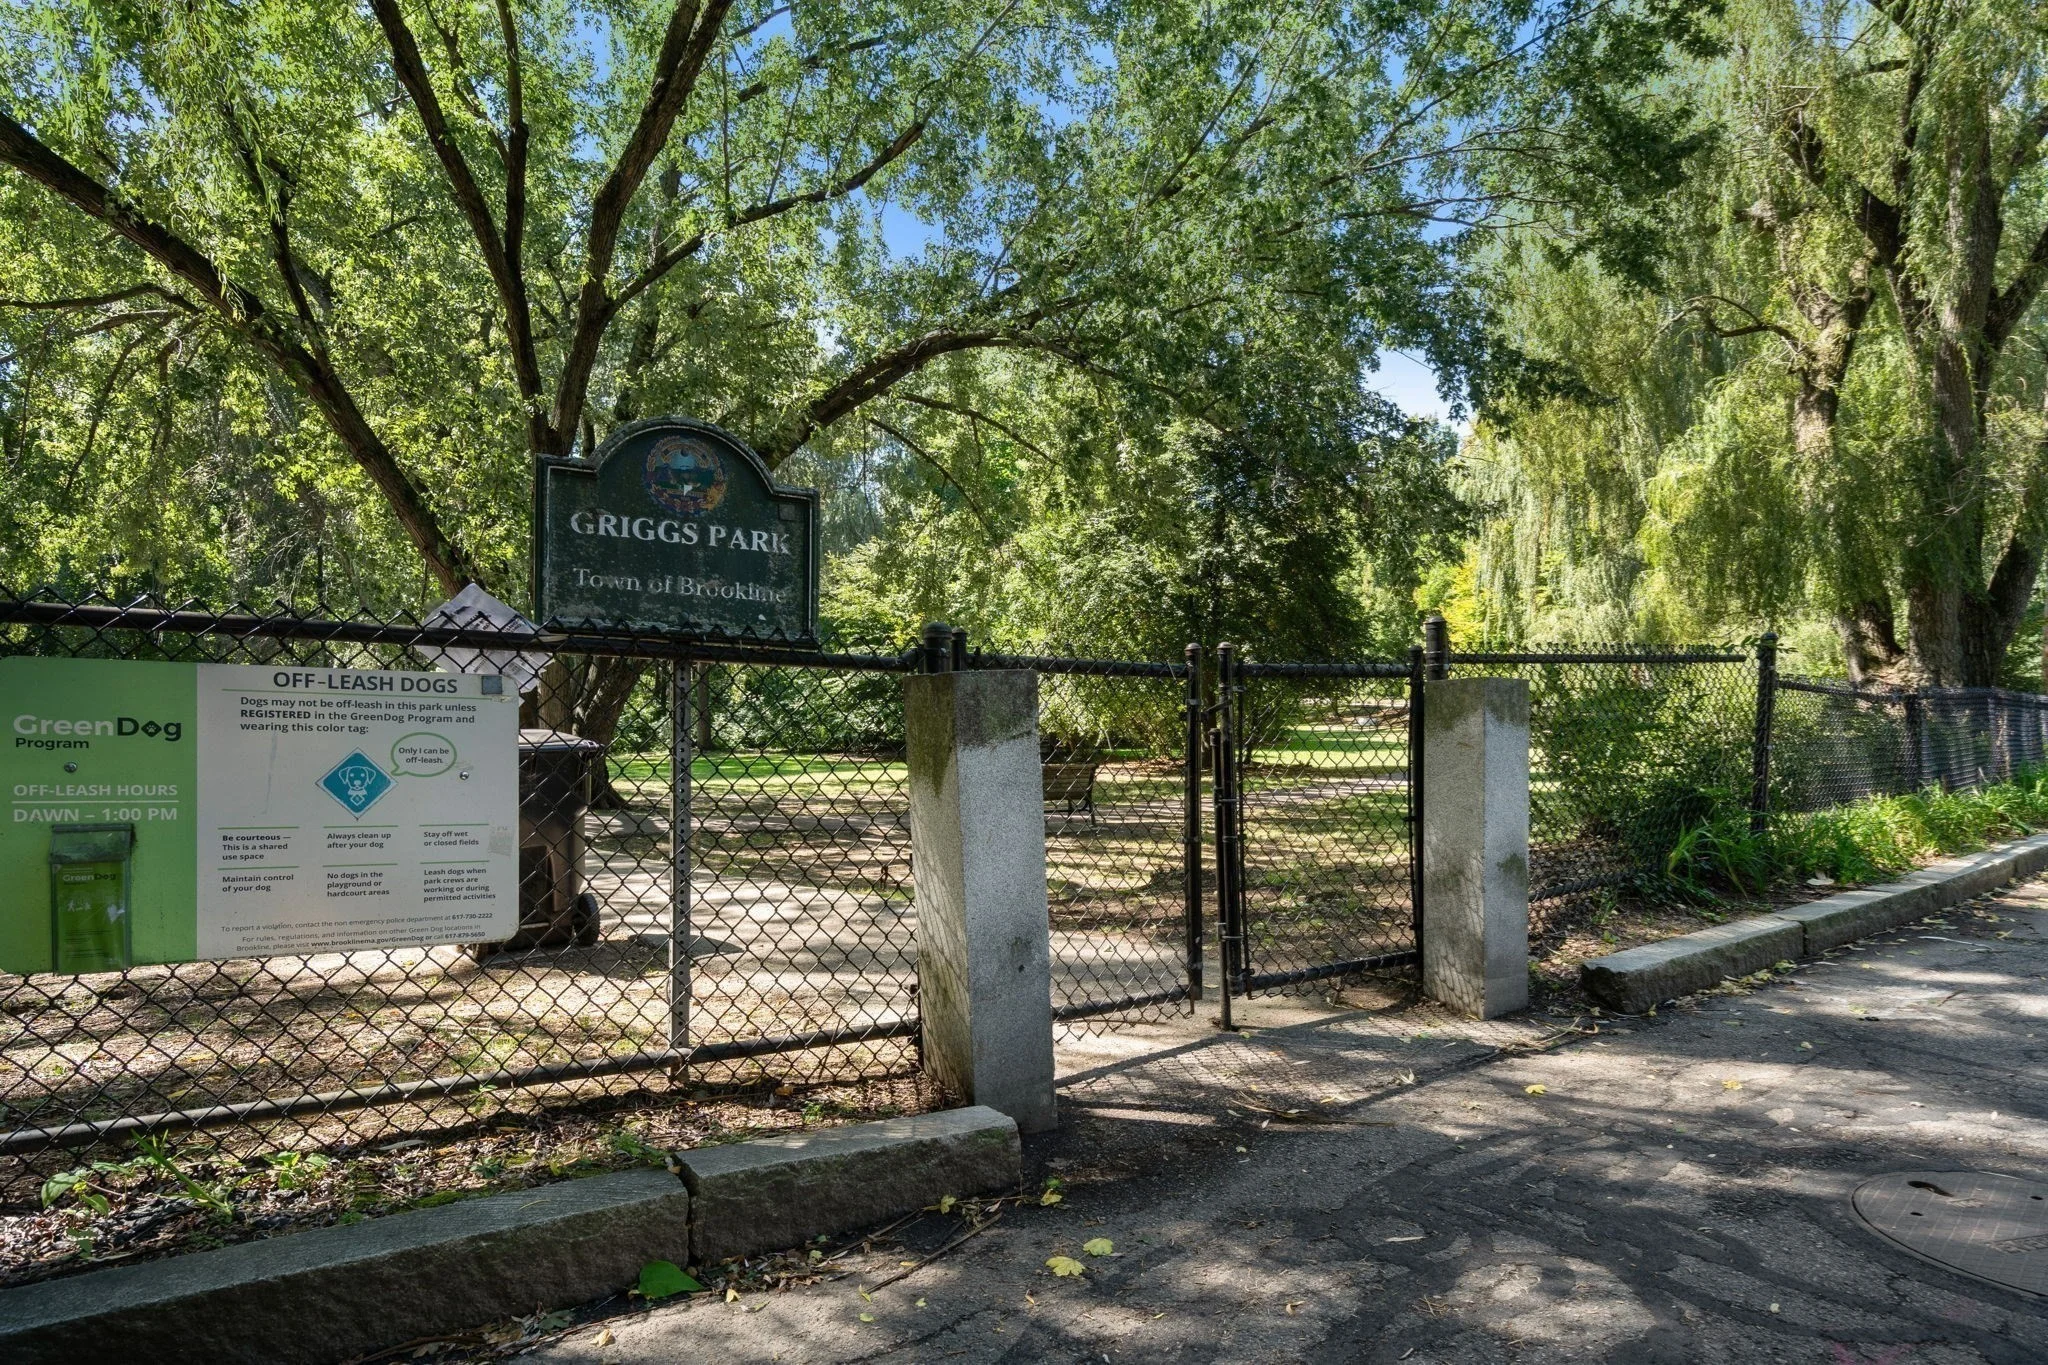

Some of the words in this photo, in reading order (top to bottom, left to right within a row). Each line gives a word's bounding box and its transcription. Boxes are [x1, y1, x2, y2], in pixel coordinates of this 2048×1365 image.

[570, 511, 699, 545] GRIGGS
[708, 524, 791, 555] PARK
[573, 567, 641, 592] Town
[649, 574, 672, 595] of
[679, 576, 787, 604] Brookline
[273, 671, 394, 692] OFF-LEASH
[401, 677, 458, 694] DOGS
[240, 696, 269, 708] Dogs
[271, 699, 296, 709] may
[299, 699, 318, 707] not
[320, 698, 333, 708] be
[336, 699, 382, 710] off-leash
[385, 700, 395, 710] in
[397, 701, 417, 711] this
[419, 702, 442, 712] park
[445, 703, 477, 712] unless
[240, 709, 311, 719] REGISTERED
[314, 711, 325, 720] in
[328, 711, 347, 721] the
[350, 712, 404, 724] GreenDog
[407, 713, 453, 724] Program
[455, 715, 475, 724] and
[240, 722, 289, 733] wearing
[291, 722, 314, 732] this
[316, 723, 345, 733] color
[348, 725, 369, 735] tag:
[15, 737, 90, 751] Program
[398, 747, 418, 756] Only
[439, 747, 450, 755] be
[13, 784, 111, 797] OFF-LEASH
[117, 784, 178, 797] HOURS
[13, 808, 80, 822] DAWN
[102, 808, 142, 821] 1:00
[147, 807, 177, 821] PM
[222, 834, 234, 842] Be
[235, 834, 281, 842] courteous
[327, 833, 356, 841] Always
[423, 831, 440, 839] Stay
[222, 843, 240, 851] This
[242, 843, 250, 851] is
[258, 842, 288, 850] shared
[349, 842, 368, 850] your
[369, 841, 384, 849] dog
[239, 853, 265, 861] space
[340, 872, 359, 880] dogs
[447, 868, 465, 876] dogs
[222, 874, 261, 883] Maintain
[423, 877, 442, 886] park
[222, 885, 231, 893] of
[233, 885, 254, 893] your
[255, 884, 271, 892] dog
[327, 880, 372, 890] playground
[465, 884, 490, 892] during
[327, 890, 367, 898] hardcourt
[423, 894, 461, 903] permitted
[231, 925, 254, 933] report
[295, 921, 320, 929] contact
[348, 918, 385, 927] emergency
[406, 915, 444, 924] department
[336, 929, 377, 939] information
[408, 926, 429, 934] Green
[273, 943, 295, 951] please
